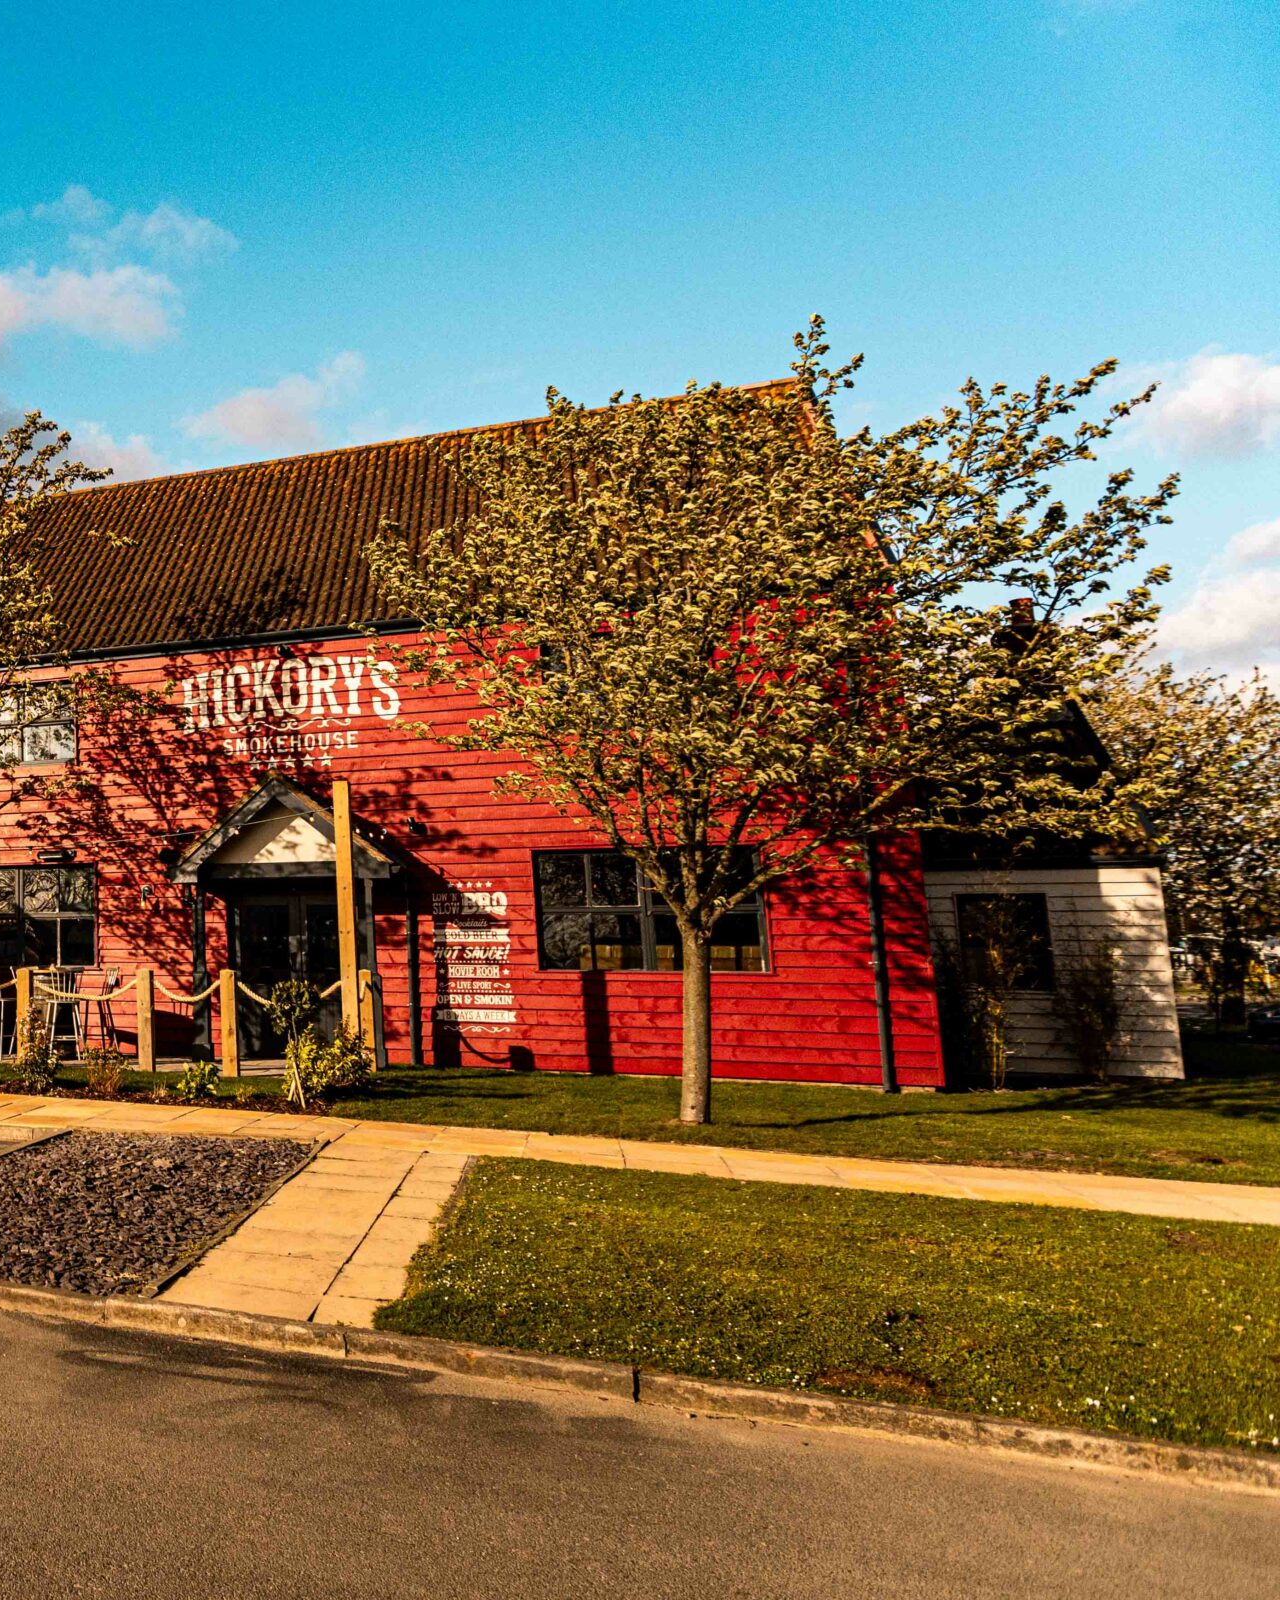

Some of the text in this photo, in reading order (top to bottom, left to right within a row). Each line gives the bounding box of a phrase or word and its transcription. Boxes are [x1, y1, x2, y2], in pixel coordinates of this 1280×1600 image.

[223, 731, 358, 756] SMOKEHOUSE
[432, 893, 447, 902] LOW
[432, 902, 460, 915] SLOW
[461, 892, 508, 916] BBQ
[445, 930, 498, 940] COLD BEER
[434, 944, 510, 960] HOT SAUCE!
[449, 966, 499, 977] MOVIE ROOM
[457, 981, 492, 989] LIVE SPORT
[437, 994, 462, 1005] OPEN
[464, 994, 472, 1004] &
[453, 1010, 474, 1020] DAYS
[476, 1011, 481, 1020] A
[483, 1011, 506, 1021] WEEK
